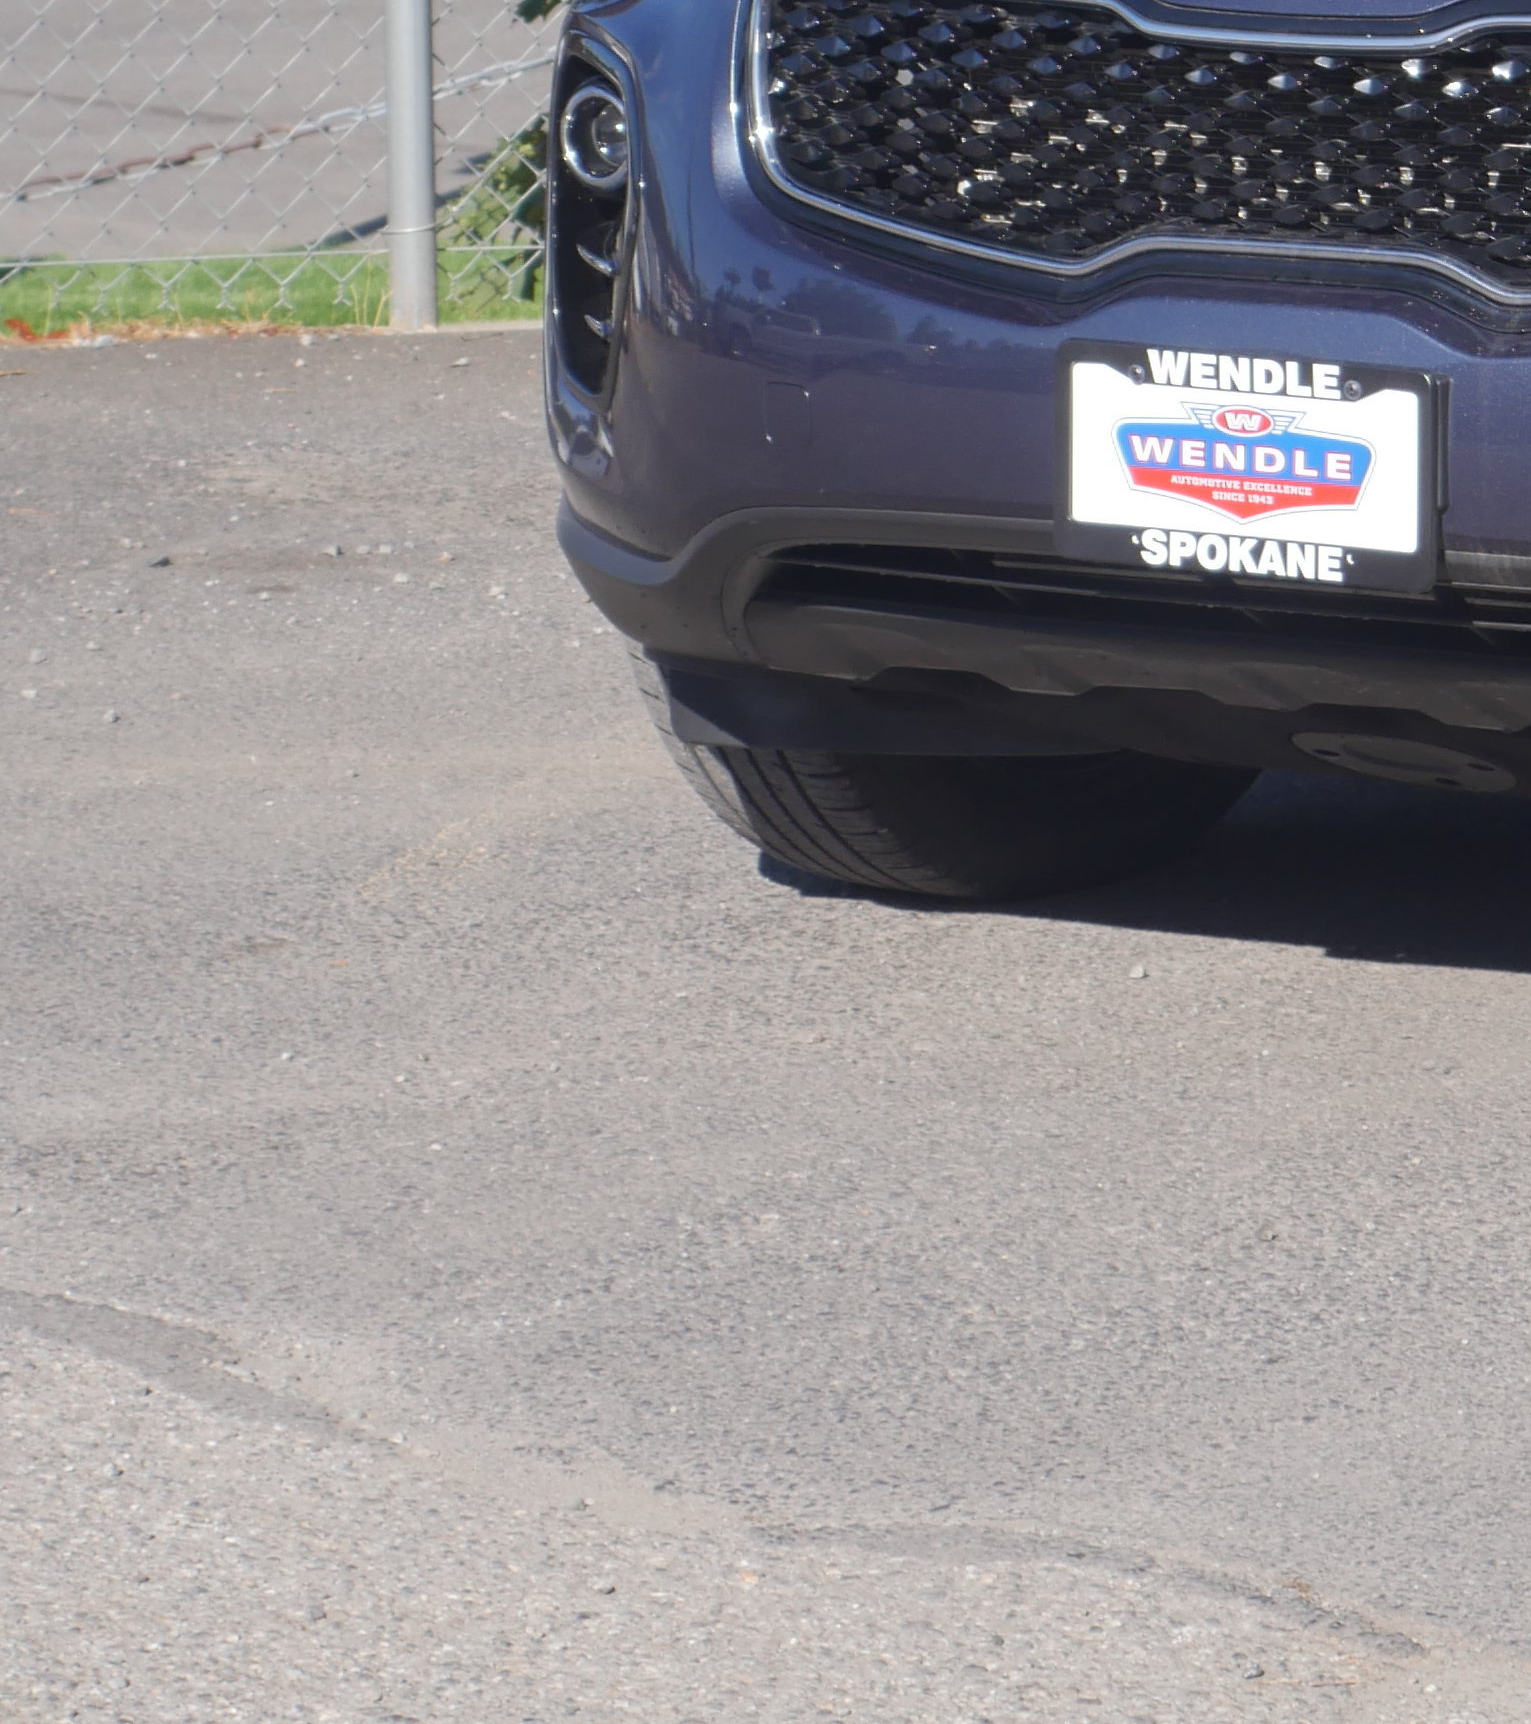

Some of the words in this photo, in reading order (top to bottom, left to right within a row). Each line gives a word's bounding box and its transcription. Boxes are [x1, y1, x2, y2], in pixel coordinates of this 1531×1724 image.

[1147, 349, 1341, 399] WENDLE
[1129, 434, 1352, 480] WENDLE
[1170, 475, 1240, 490] AUTOMOTIVE
[1243, 481, 1312, 496] EXCELLENCE
[1212, 491, 1245, 502] SINCE
[1248, 494, 1273, 504] 1943
[1140, 528, 1343, 583] SPOKANE
